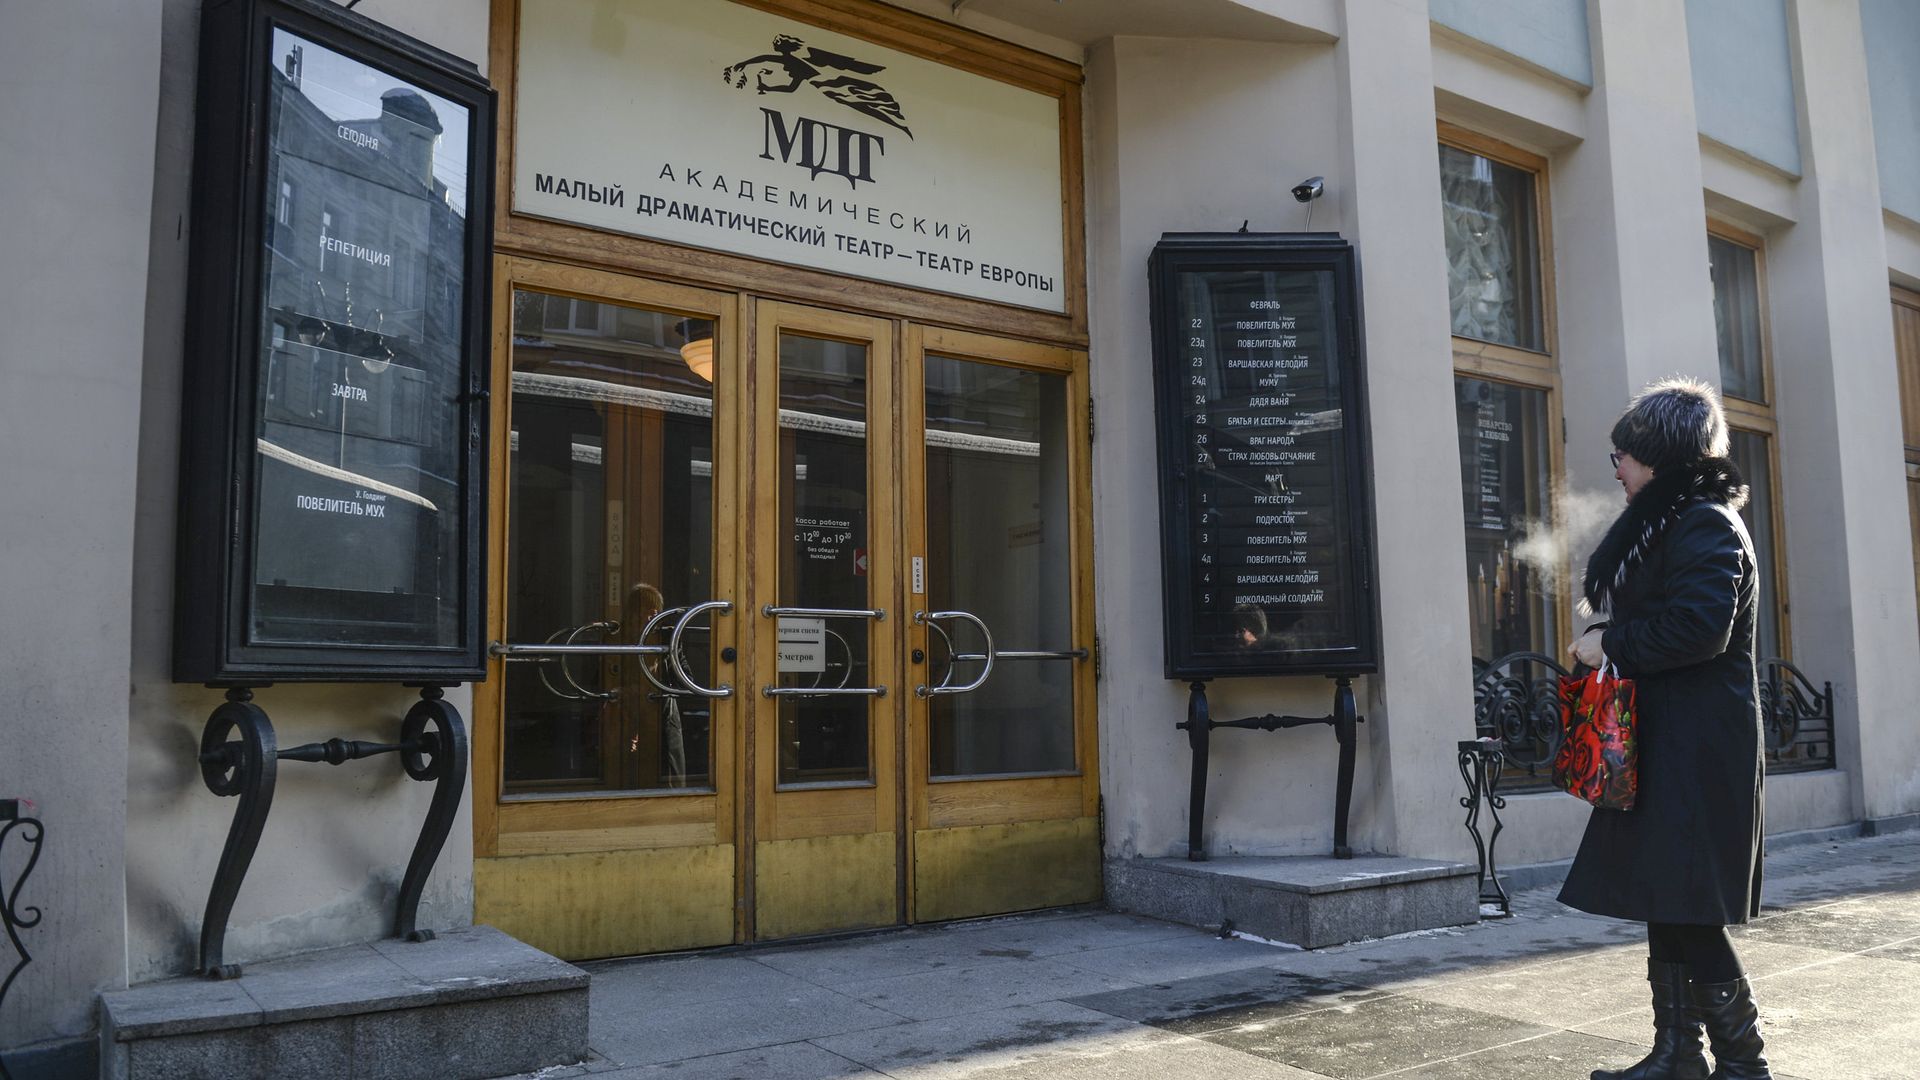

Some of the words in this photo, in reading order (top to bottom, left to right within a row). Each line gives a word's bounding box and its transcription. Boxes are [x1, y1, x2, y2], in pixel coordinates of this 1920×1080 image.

[337, 124, 379, 152] СЕГОДНЯ
[759, 106, 885, 190] МДТ
[659, 163, 971, 244] АКАДЕМИЧЕСКИЙ
[535, 173, 624, 208] МАЛЫЙ
[637, 194, 825, 248] ДРАМАТИЧЕСКИЙ
[980, 263, 1054, 293] ЕВРОПЫ
[319, 234, 391, 268] РЕПЕТИЦИЯ
[1250, 300, 1280, 309] ФЕВРАЛЬ
[1191, 318, 1202, 328] 22
[1236, 321, 1280, 330] ПОВЕЛИТЕЛЬ
[1281, 321, 1295, 329] МУХ
[1190, 337, 1205, 348] 23д
[1237, 339, 1281, 348] ПОВЕЛИТЕЛЬ
[1282, 339, 1296, 348] МУХ
[1192, 357, 1203, 367] 23
[1228, 360, 1274, 369] ВАРШАВСКАЯ
[1274, 360, 1309, 370] МЕЛОДИЯ
[1192, 376, 1206, 386] 24д
[1259, 378, 1279, 387] МУМУ
[331, 382, 368, 402] ЗАВТРА
[1195, 394, 1206, 405] 24
[1249, 397, 1269, 407] ДЯДЯ
[1270, 397, 1289, 406] ВАНЯ
[1196, 414, 1207, 424] 25
[1227, 417, 1252, 426] БРАТЬЯ
[1253, 417, 1259, 425] И
[1197, 434, 1207, 444] 26
[1249, 437, 1266, 446] ВРАГ
[1267, 436, 1295, 446] НАРОДА
[1198, 453, 1208, 463] 27
[1228, 452, 1248, 461] СТРАХ
[1280, 452, 1316, 461] ОТЧАЯНИЕ
[1264, 474, 1283, 483] МАРТ
[1202, 493, 1208, 503] 1
[1254, 495, 1268, 504] ТРИ
[1268, 495, 1295, 504] СЕСТРЫ
[297, 494, 363, 516] ПОВЕЛИТЕЛЬ
[365, 503, 385, 518] МУХ
[795, 516, 817, 525] Касса
[1202, 514, 1208, 523] 2
[1255, 515, 1295, 525] ПОДРОСТОК
[1202, 533, 1208, 543] 3
[1247, 536, 1291, 545] ПОВЕЛИТЕЛЬ
[1293, 535, 1307, 544] МУХ
[1201, 554, 1211, 564] 4д
[1246, 556, 1291, 564] ПОВЕЛИТЕЛЬ
[1292, 555, 1307, 563] МУХ
[1204, 574, 1210, 583] 4
[1237, 575, 1284, 584] ВАРШАВСКАЯ
[1285, 574, 1319, 584] МЕЛОДИЯ
[1204, 593, 1210, 603] 5
[1235, 593, 1286, 604] ШОКОЛАДНЫЙ
[1287, 594, 1324, 604] СОЛДАТИК
[784, 654, 814, 663] метров
